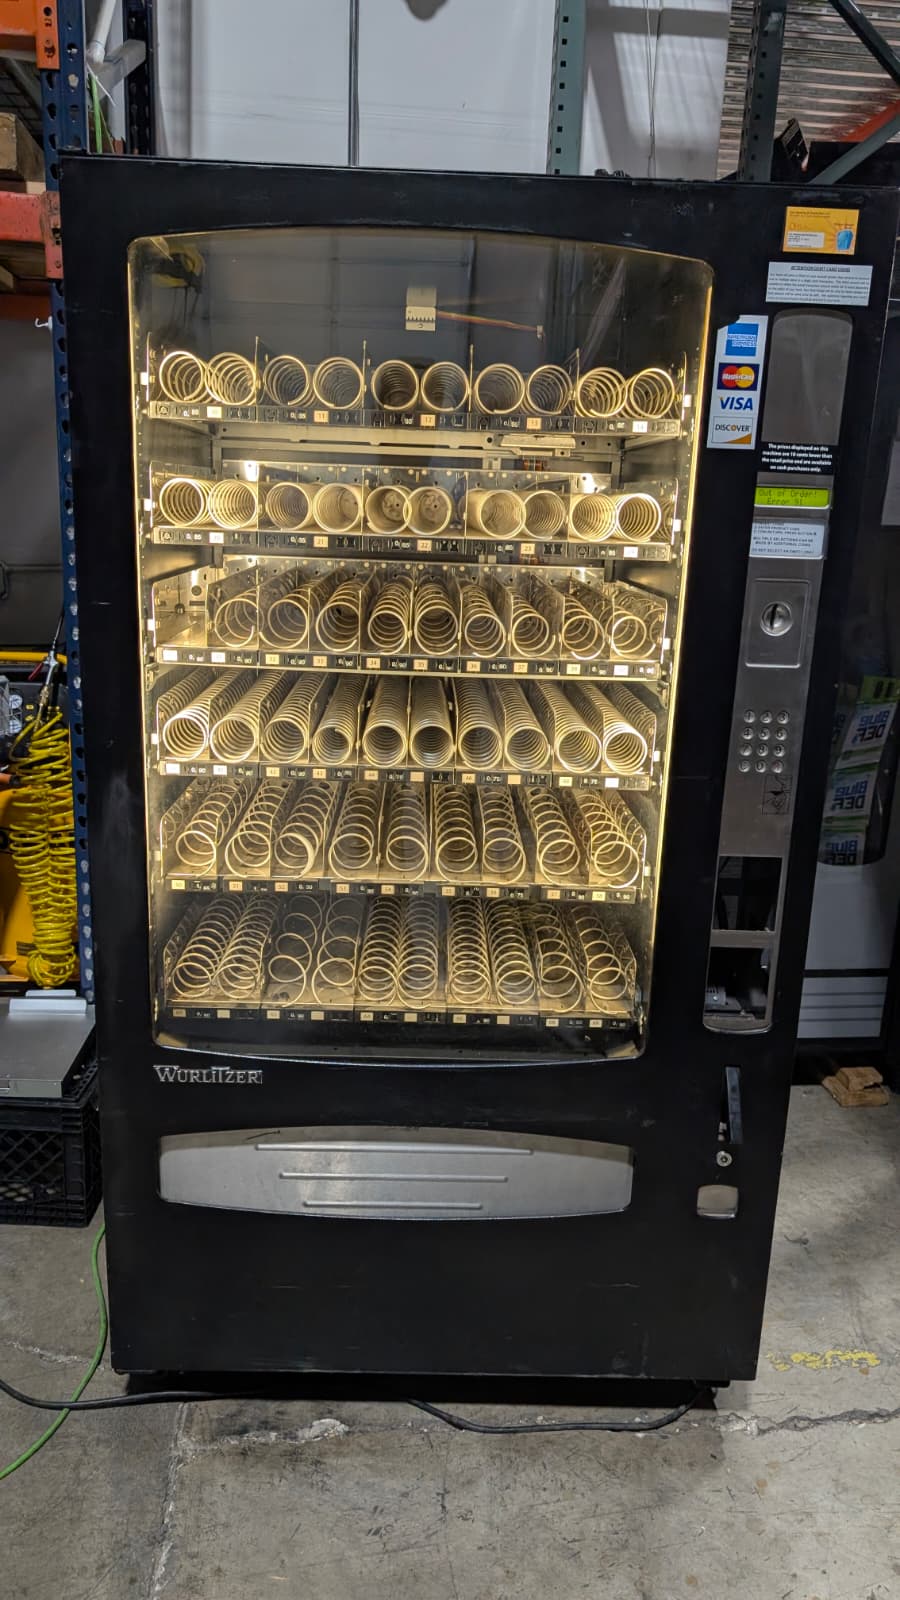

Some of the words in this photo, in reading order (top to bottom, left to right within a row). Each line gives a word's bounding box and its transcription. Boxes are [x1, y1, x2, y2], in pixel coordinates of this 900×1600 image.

[720, 396, 753, 411] VISA
[715, 423, 750, 432] DISCOVER
[759, 489, 772, 497] Out
[791, 489, 816, 498] Order!
